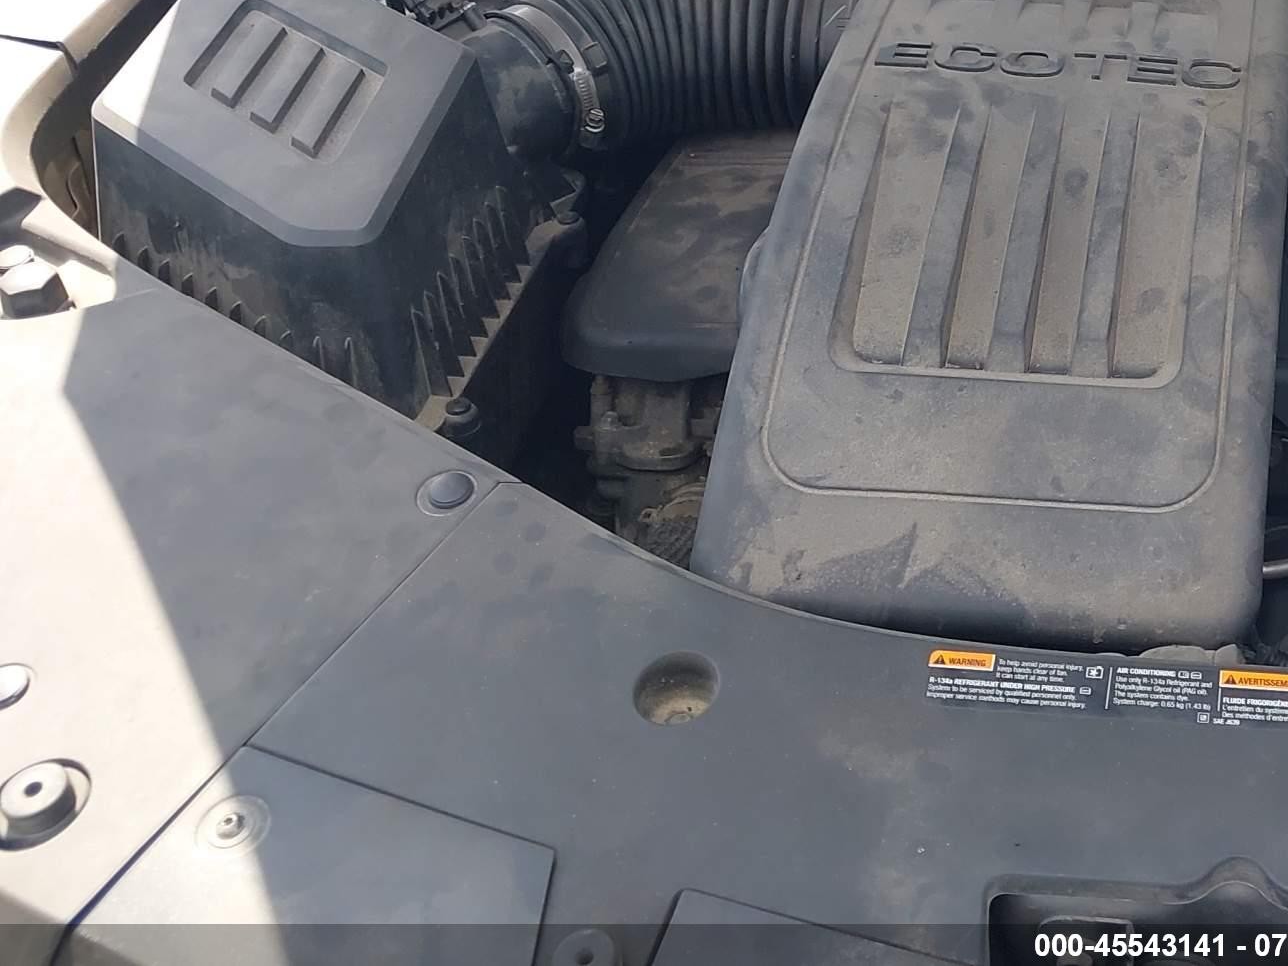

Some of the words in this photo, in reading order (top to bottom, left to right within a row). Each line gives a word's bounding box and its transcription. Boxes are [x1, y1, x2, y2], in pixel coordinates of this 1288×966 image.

[874, 40, 1242, 90] ECOTEC
[948, 657, 986, 667] WARNING
[1038, 661, 1065, 670] personal
[1130, 668, 1176, 677] CONDITIONING
[954, 678, 998, 687] REFRIGERANT
[1000, 681, 1023, 689] UNDER
[1041, 684, 1076, 692] PRESSURE
[1128, 676, 1141, 684] only
[1166, 679, 1199, 688] Refrigerant
[928, 684, 951, 692] System
[1127, 691, 1148, 700] system
[1040, 699, 1066, 708] personal
[1114, 698, 1136, 706] System
[1186, 702, 1204, 710] (1.43
[1223, 697, 1246, 705] FLUIDE
